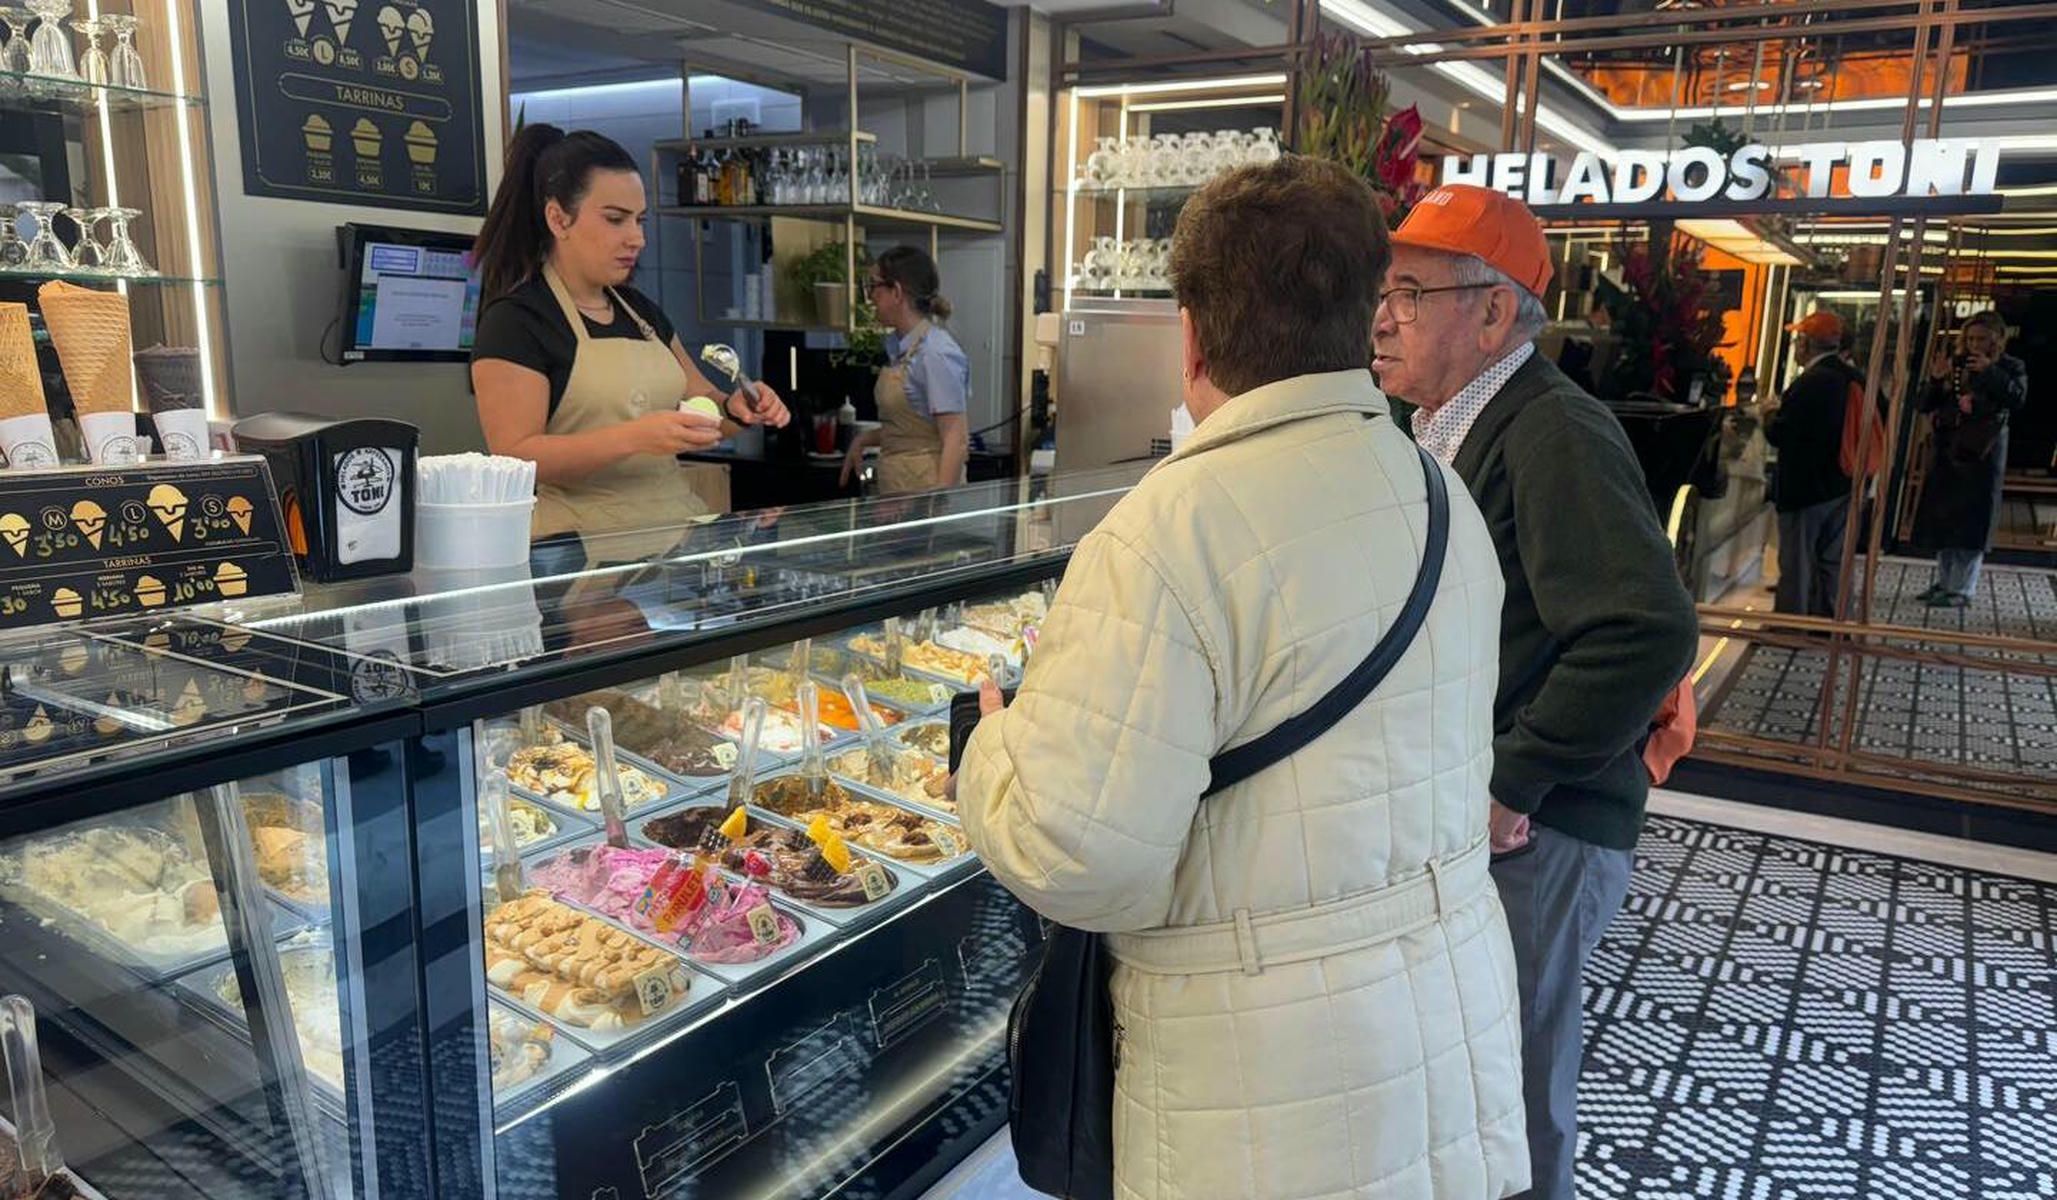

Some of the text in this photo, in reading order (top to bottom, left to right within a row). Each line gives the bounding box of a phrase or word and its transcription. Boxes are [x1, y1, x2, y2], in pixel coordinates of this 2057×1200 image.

[335, 86, 405, 111] TARRINAS
[1441, 138, 2001, 205] HELADOS TONI
[85, 475, 124, 488] CONOS
[351, 485, 385, 504] TONI
[47, 512, 64, 527] M
[103, 553, 152, 569] TARRINAS
